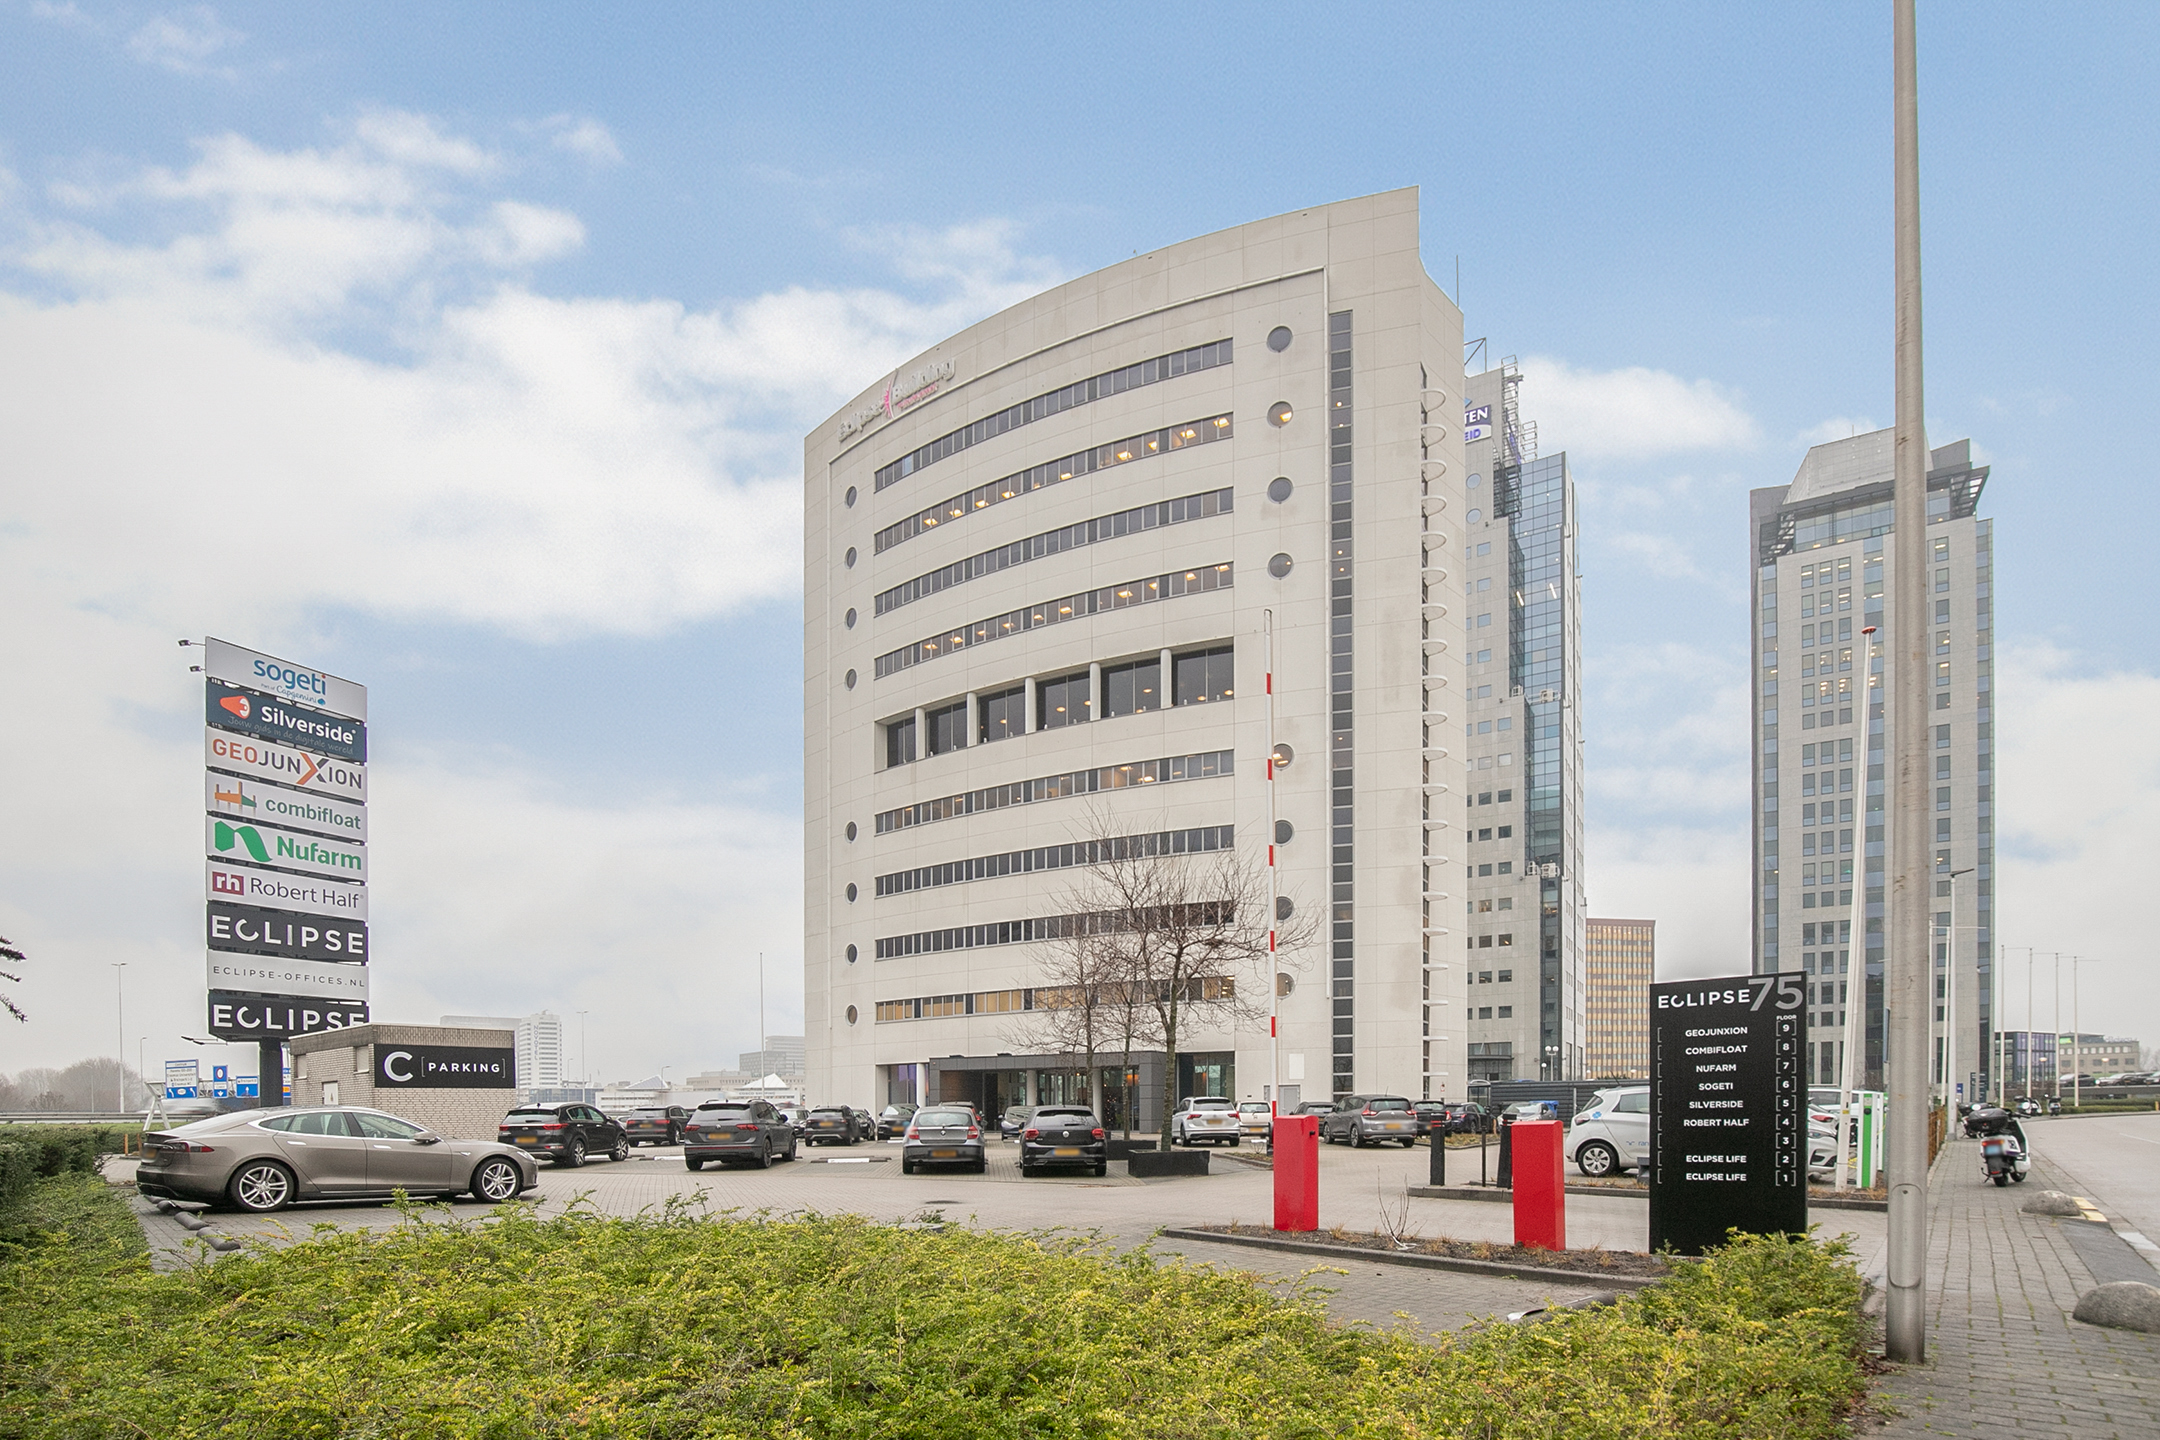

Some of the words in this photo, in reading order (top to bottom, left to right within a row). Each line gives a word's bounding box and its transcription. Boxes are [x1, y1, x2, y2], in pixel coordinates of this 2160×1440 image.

[253, 659, 326, 696] sogeti
[276, 685, 317, 704] Capgemini
[228, 715, 252, 728] Jouw
[261, 706, 354, 745] Silverside
[212, 737, 362, 790] GEOJUNXION
[265, 799, 361, 830] combifloat
[277, 835, 362, 870] Nufarm
[250, 877, 318, 904] Robert
[322, 888, 359, 909] Half
[211, 914, 364, 955] ECLIPSE
[213, 965, 365, 988] ECLIPSE-OFFICES.NL
[1657, 988, 1750, 1009] ECLIPSE
[1748, 974, 1804, 1012] 75
[1685, 1026, 1748, 1038] GEOJUNXION
[1782, 1024, 1790, 1032] 9
[1685, 1044, 1748, 1055] COMBIFLOAT
[1782, 1043, 1790, 1051] 8
[383, 1051, 414, 1083] C
[427, 1062, 501, 1073] PARKING
[1695, 1063, 1737, 1073] NUFARM
[1782, 1061, 1790, 1070] 7
[1698, 1082, 1734, 1091] SOGETI
[1782, 1080, 1790, 1089] 6
[1689, 1100, 1744, 1109] SILVERSIDE
[1782, 1099, 1790, 1107] 5
[1683, 1118, 1722, 1127] ROBERT
[1723, 1118, 1750, 1127] HALF
[1782, 1118, 1790, 1126] 4
[1782, 1136, 1790, 1145] 3
[1685, 1155, 1724, 1163] ECLIPSE
[1726, 1155, 1747, 1163] LIFE
[1782, 1155, 1790, 1163] 2
[1685, 1172, 1724, 1181] ECLIPSE
[1725, 1173, 1747, 1181] LIFE
[1782, 1174, 1788, 1182] 1
